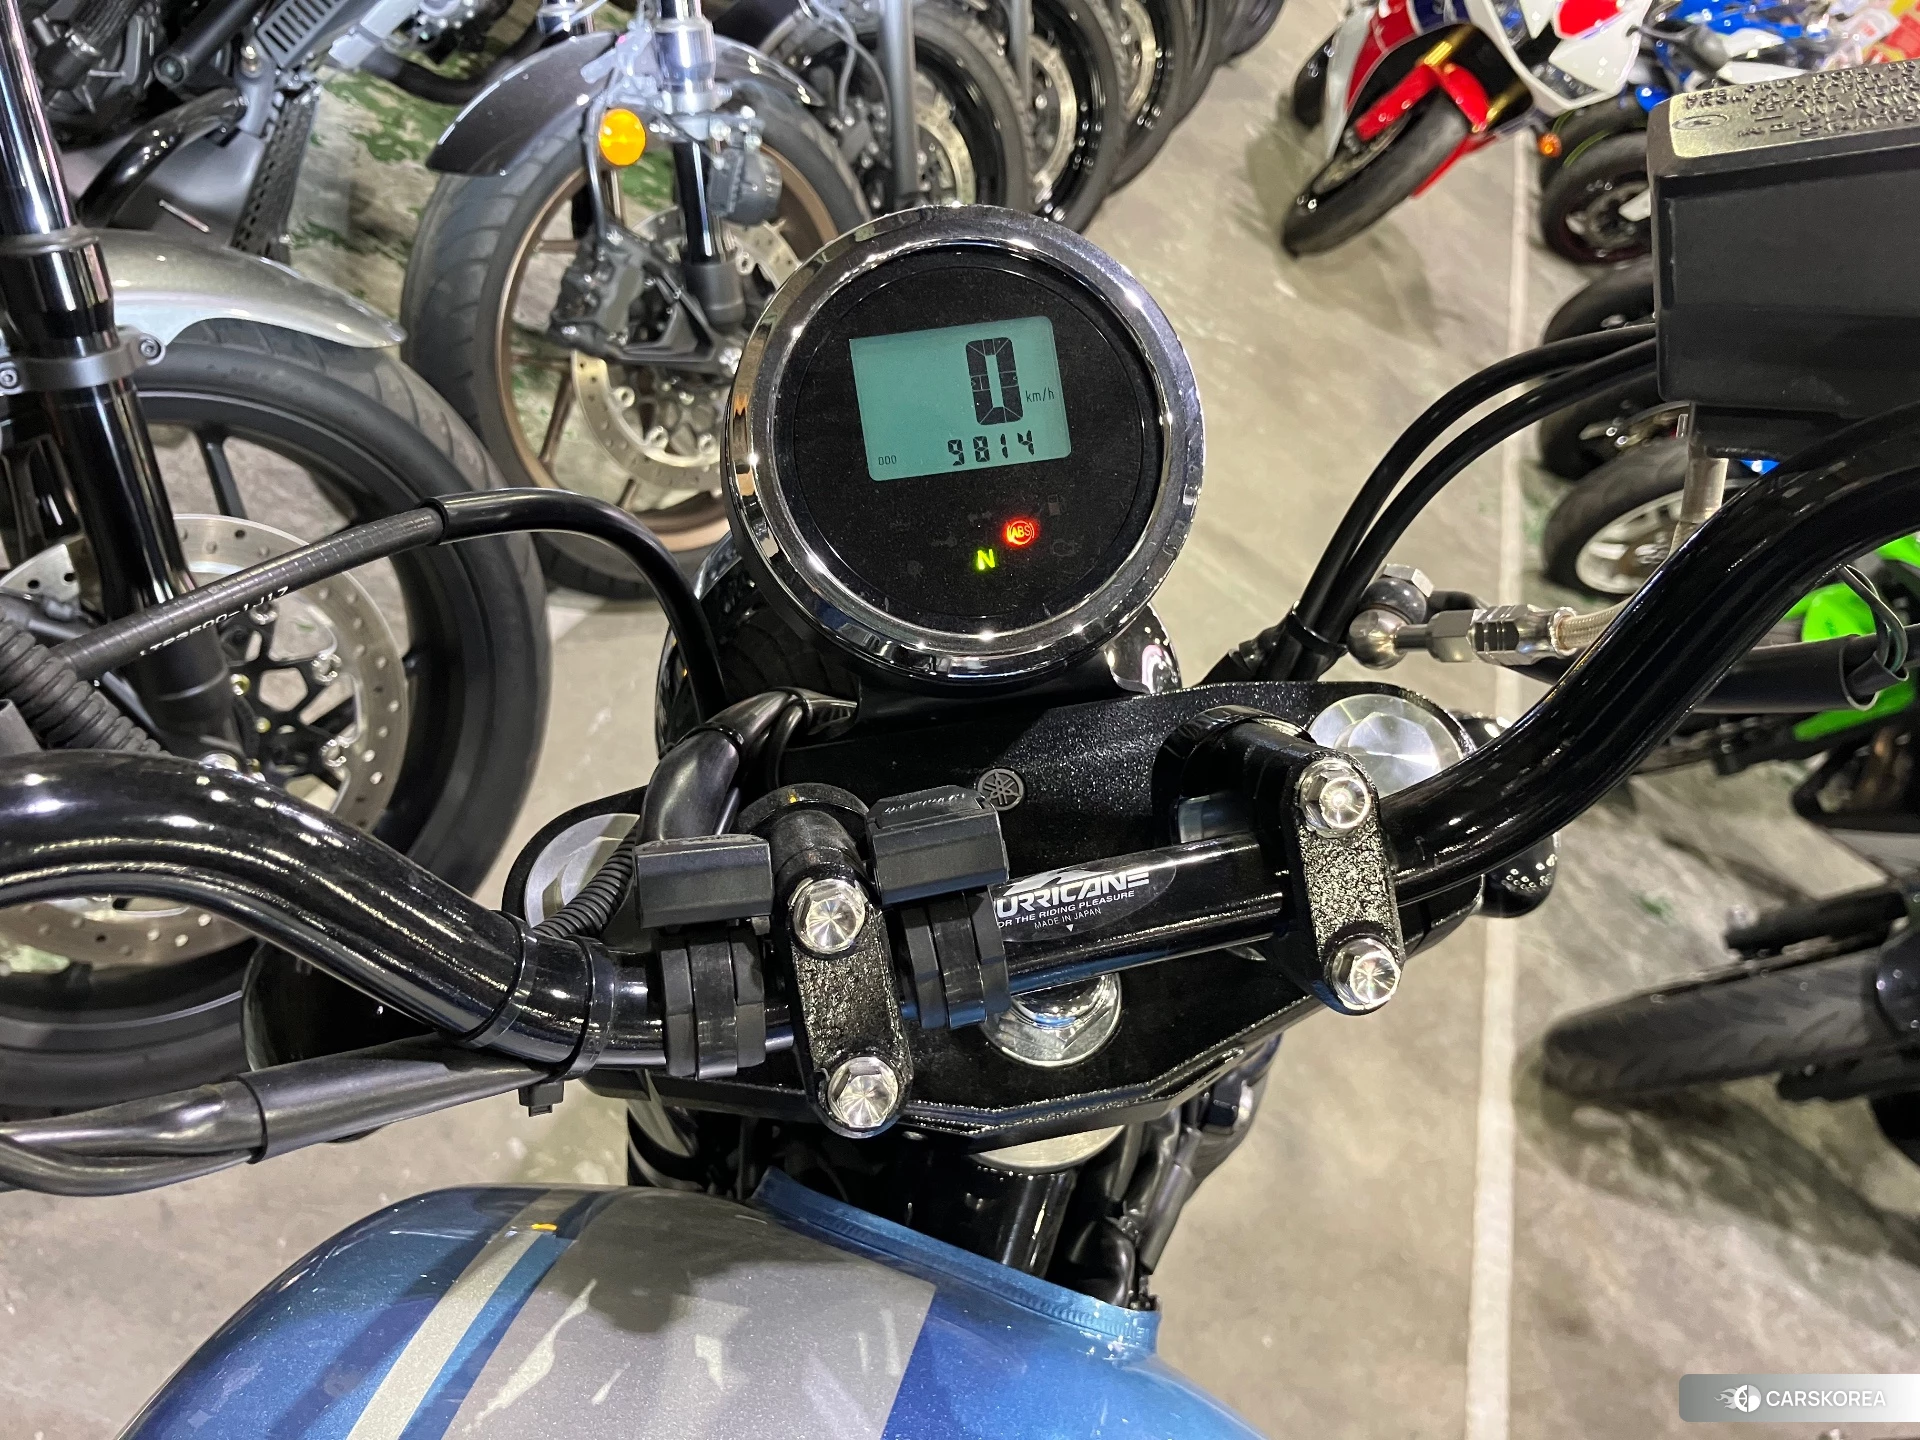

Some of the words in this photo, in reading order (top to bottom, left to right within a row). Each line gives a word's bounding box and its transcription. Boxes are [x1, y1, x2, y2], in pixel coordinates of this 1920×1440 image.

[966, 337, 1023, 425] 0
[1025, 387, 1055, 403] km/h
[948, 430, 1035, 466] 9814
[1010, 525, 1031, 539] ABS
[977, 549, 995, 570] N
[994, 871, 1150, 918] URRICANE
[998, 919, 1013, 928] OR
[1015, 913, 1036, 924] THE
[1039, 904, 1076, 918] RIDING
[1078, 891, 1135, 909] PLEASURE
[1034, 917, 1059, 929] MADE
[1062, 914, 1072, 922] IN
[1074, 907, 1102, 920] JAPAN
